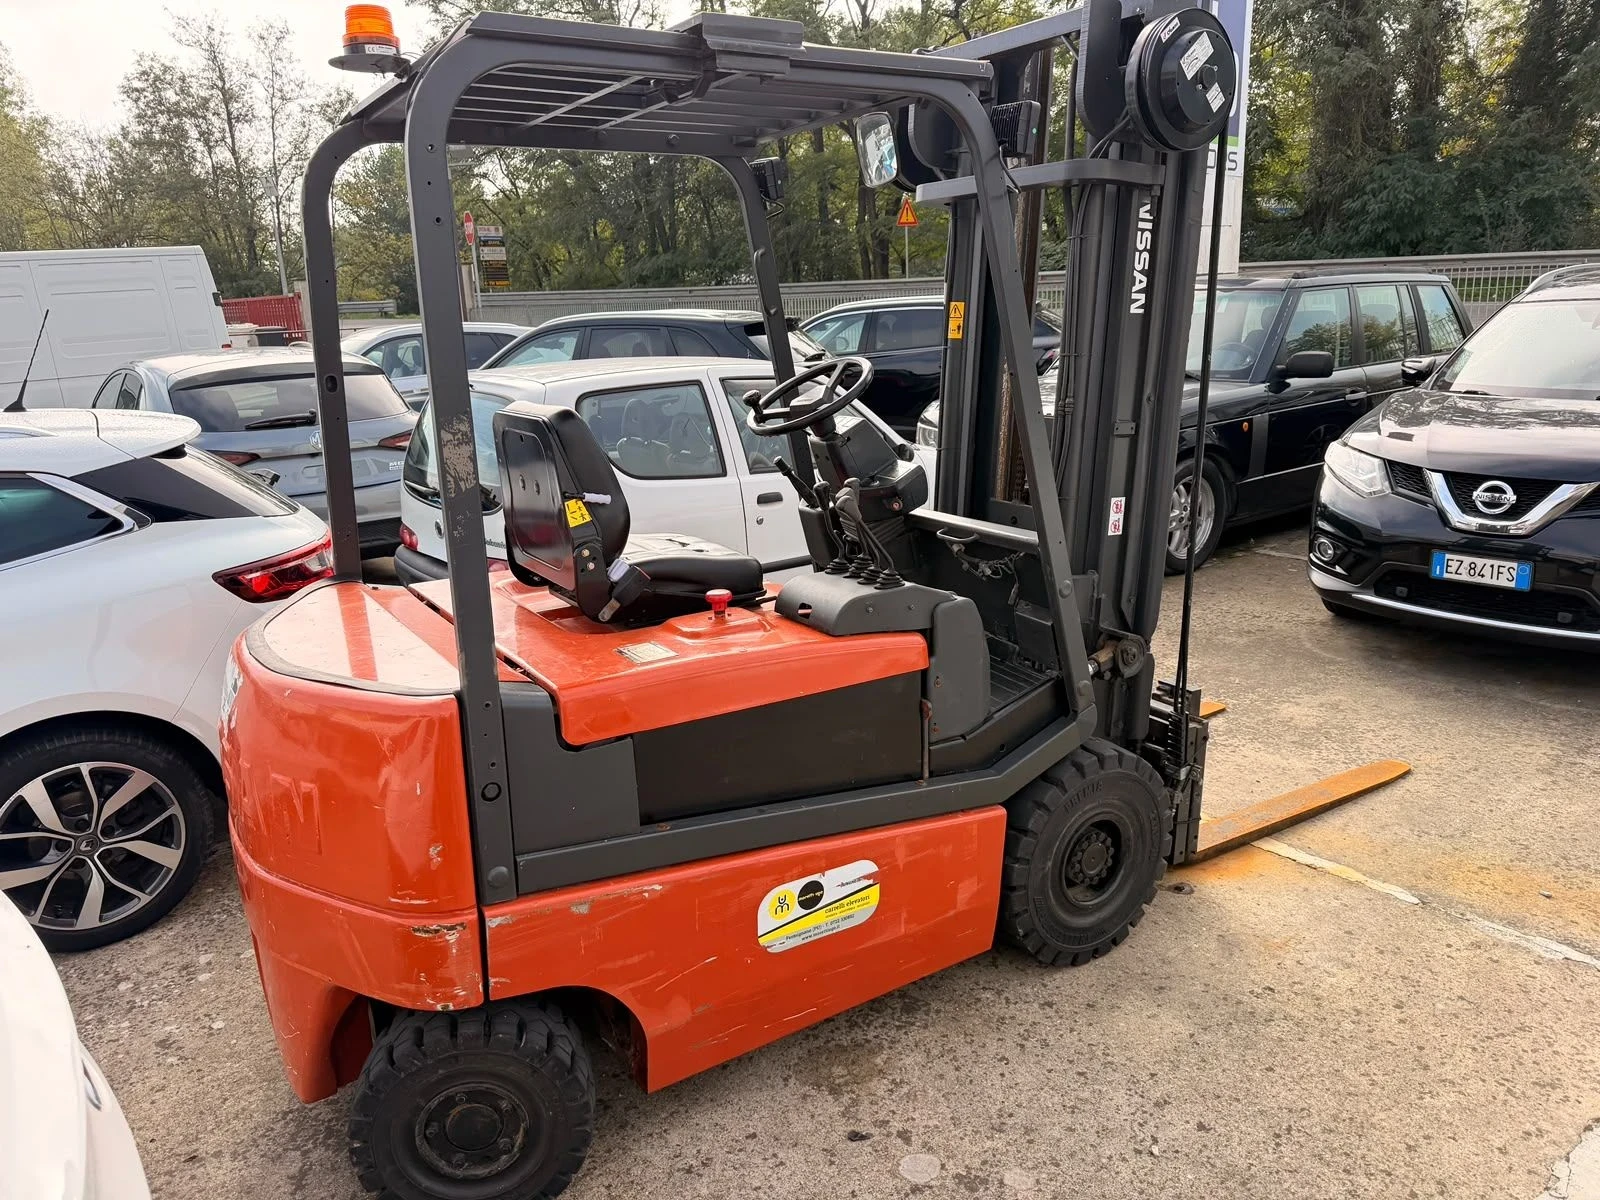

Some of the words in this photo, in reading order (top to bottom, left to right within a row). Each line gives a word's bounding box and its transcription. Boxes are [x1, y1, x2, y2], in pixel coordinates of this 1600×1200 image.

[1129, 199, 1154, 314] NISSAN
[1475, 492, 1512, 502] NISSAN
[1445, 558, 1464, 576] EZ
[1467, 561, 1516, 583] 841FS
